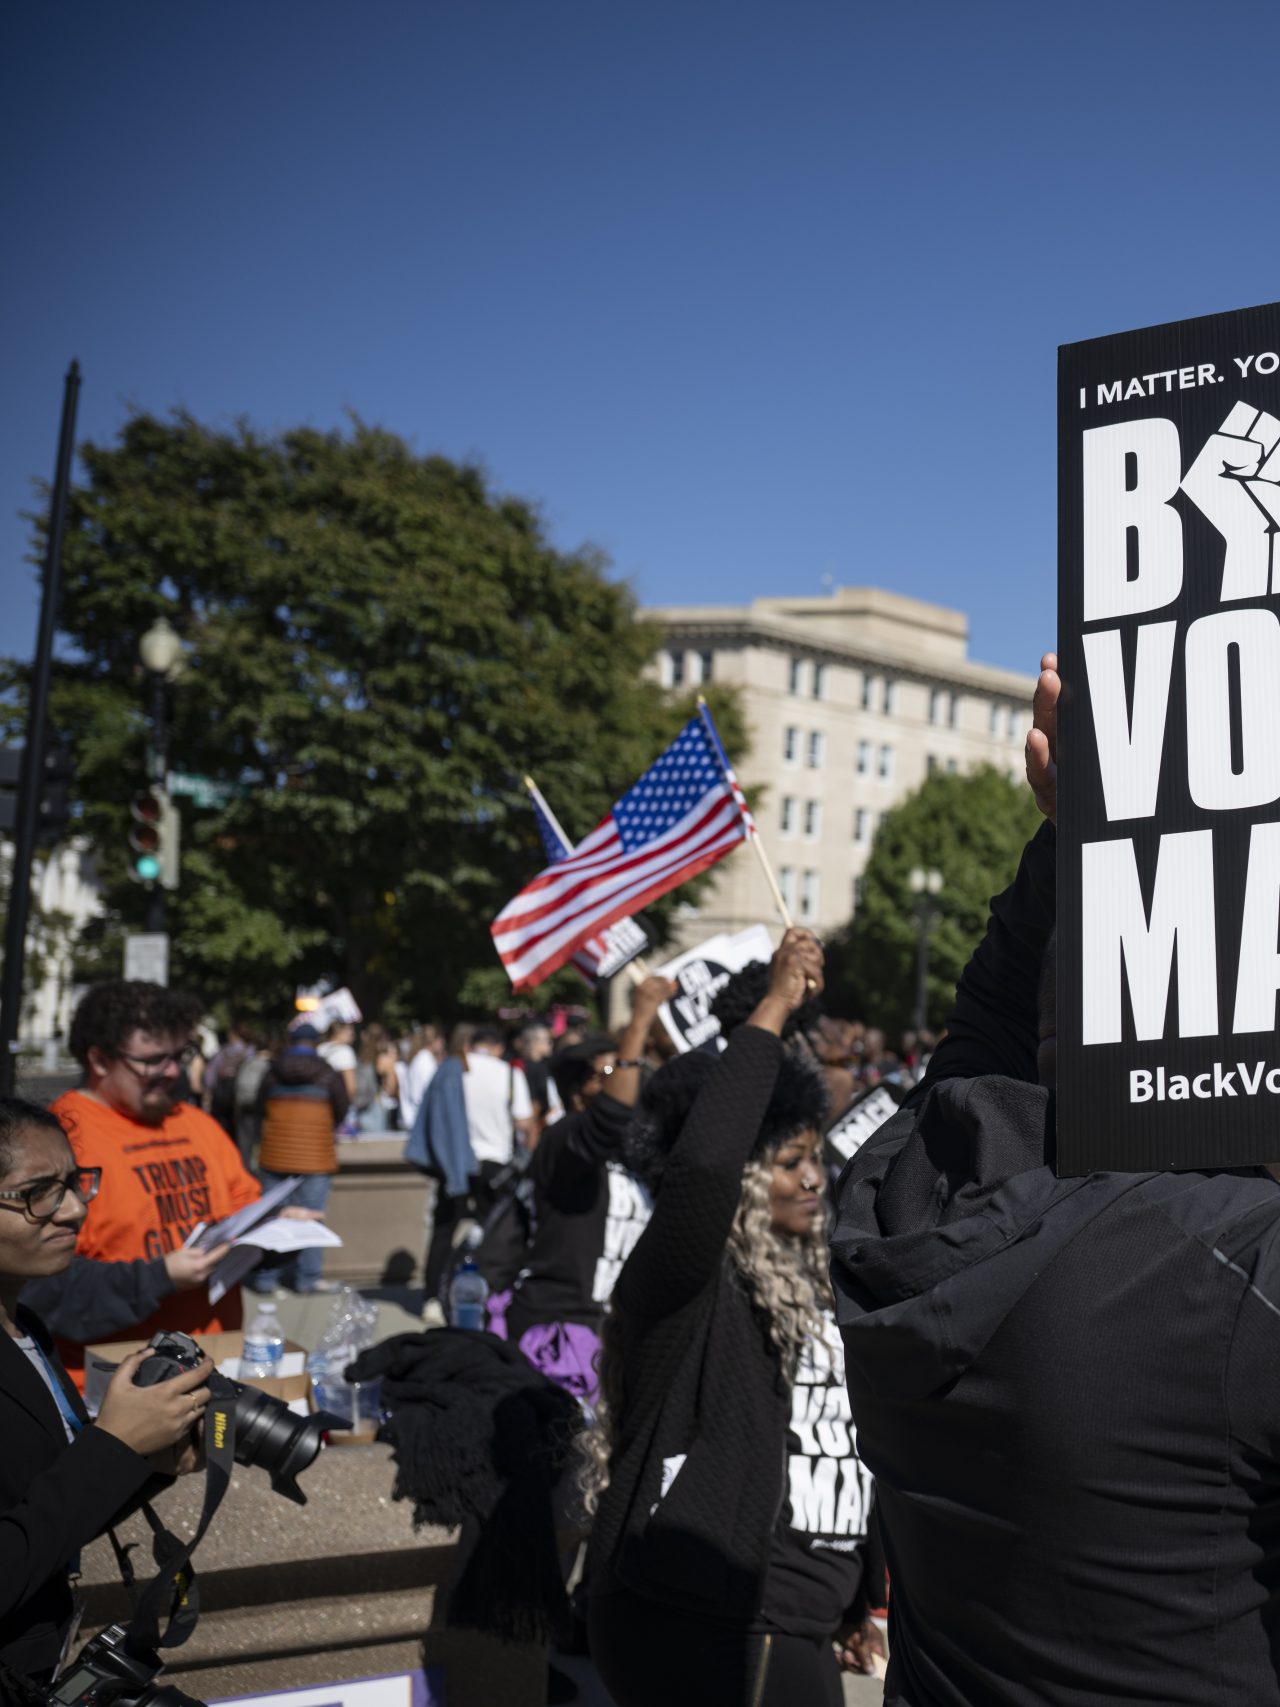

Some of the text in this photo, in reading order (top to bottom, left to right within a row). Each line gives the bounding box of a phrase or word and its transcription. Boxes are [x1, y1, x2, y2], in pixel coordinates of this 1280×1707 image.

[1079, 387, 1086, 409] I
[1097, 365, 1225, 406] MATTER.
[132, 1156, 207, 1194] TRUMP
[155, 1185, 213, 1225] MUST
[213, 1410, 228, 1449] Nikon
